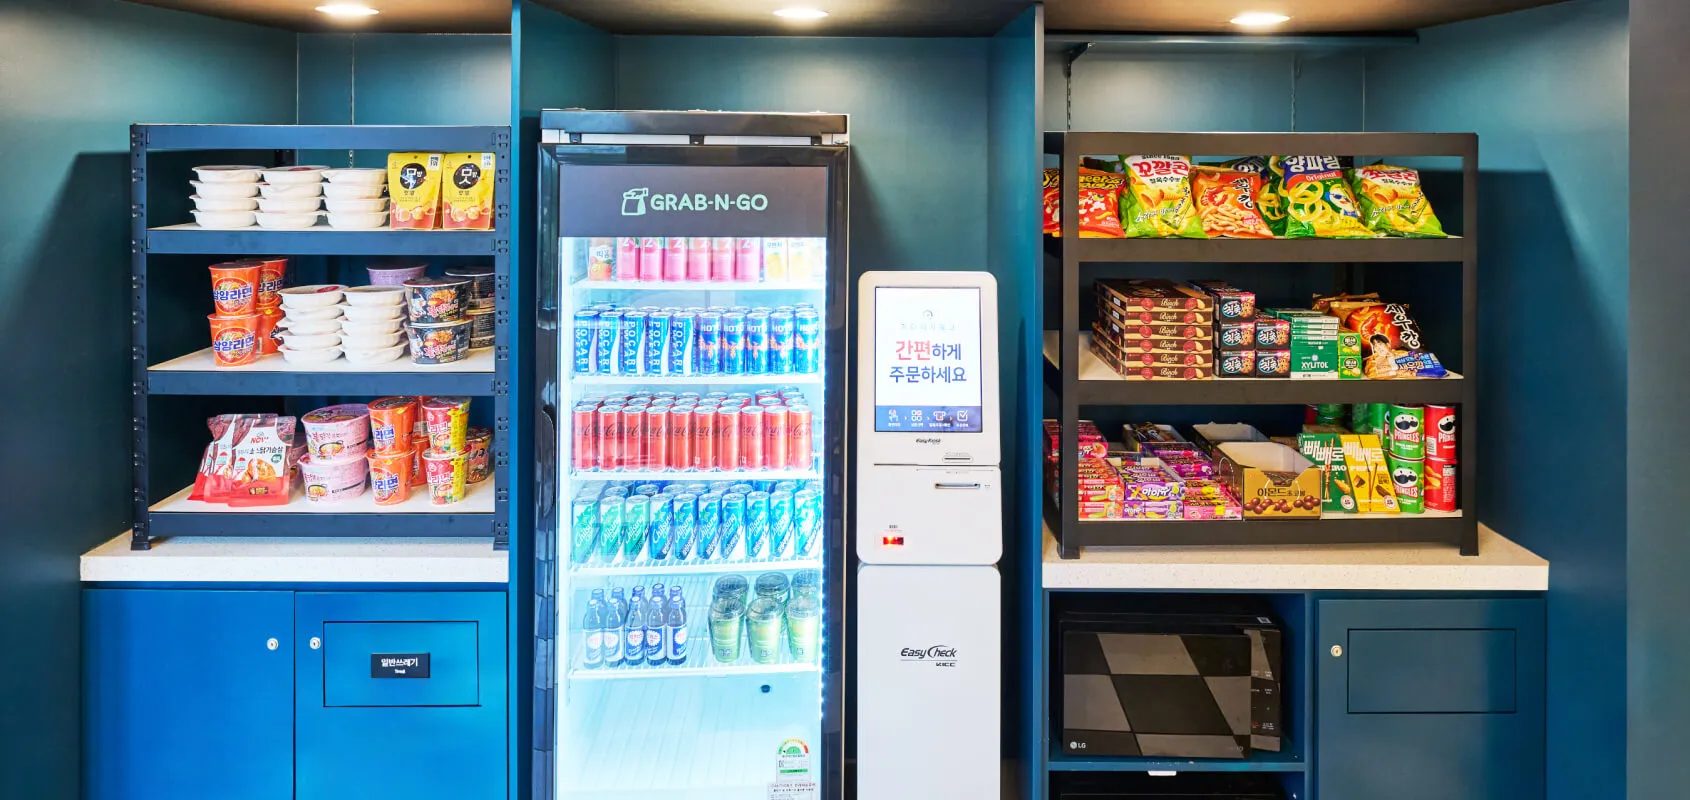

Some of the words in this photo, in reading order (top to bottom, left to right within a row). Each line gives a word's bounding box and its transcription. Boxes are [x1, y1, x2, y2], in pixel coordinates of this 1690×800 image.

[1132, 160, 1189, 178] 꼬깔콘
[650, 193, 769, 211] GRAB-N-GO
[1384, 304, 1421, 349] 새우깡
[628, 320, 636, 372] POCARI
[653, 320, 661, 372] POCARI
[896, 340, 962, 361] 간편하게
[889, 365, 968, 384] 주문하세요
[1301, 361, 1329, 369] XYLITOL
[1394, 427, 1420, 443] PRINGLES
[1304, 440, 1345, 465] 빼빼로
[381, 656, 418, 667] 일반쓰레기
